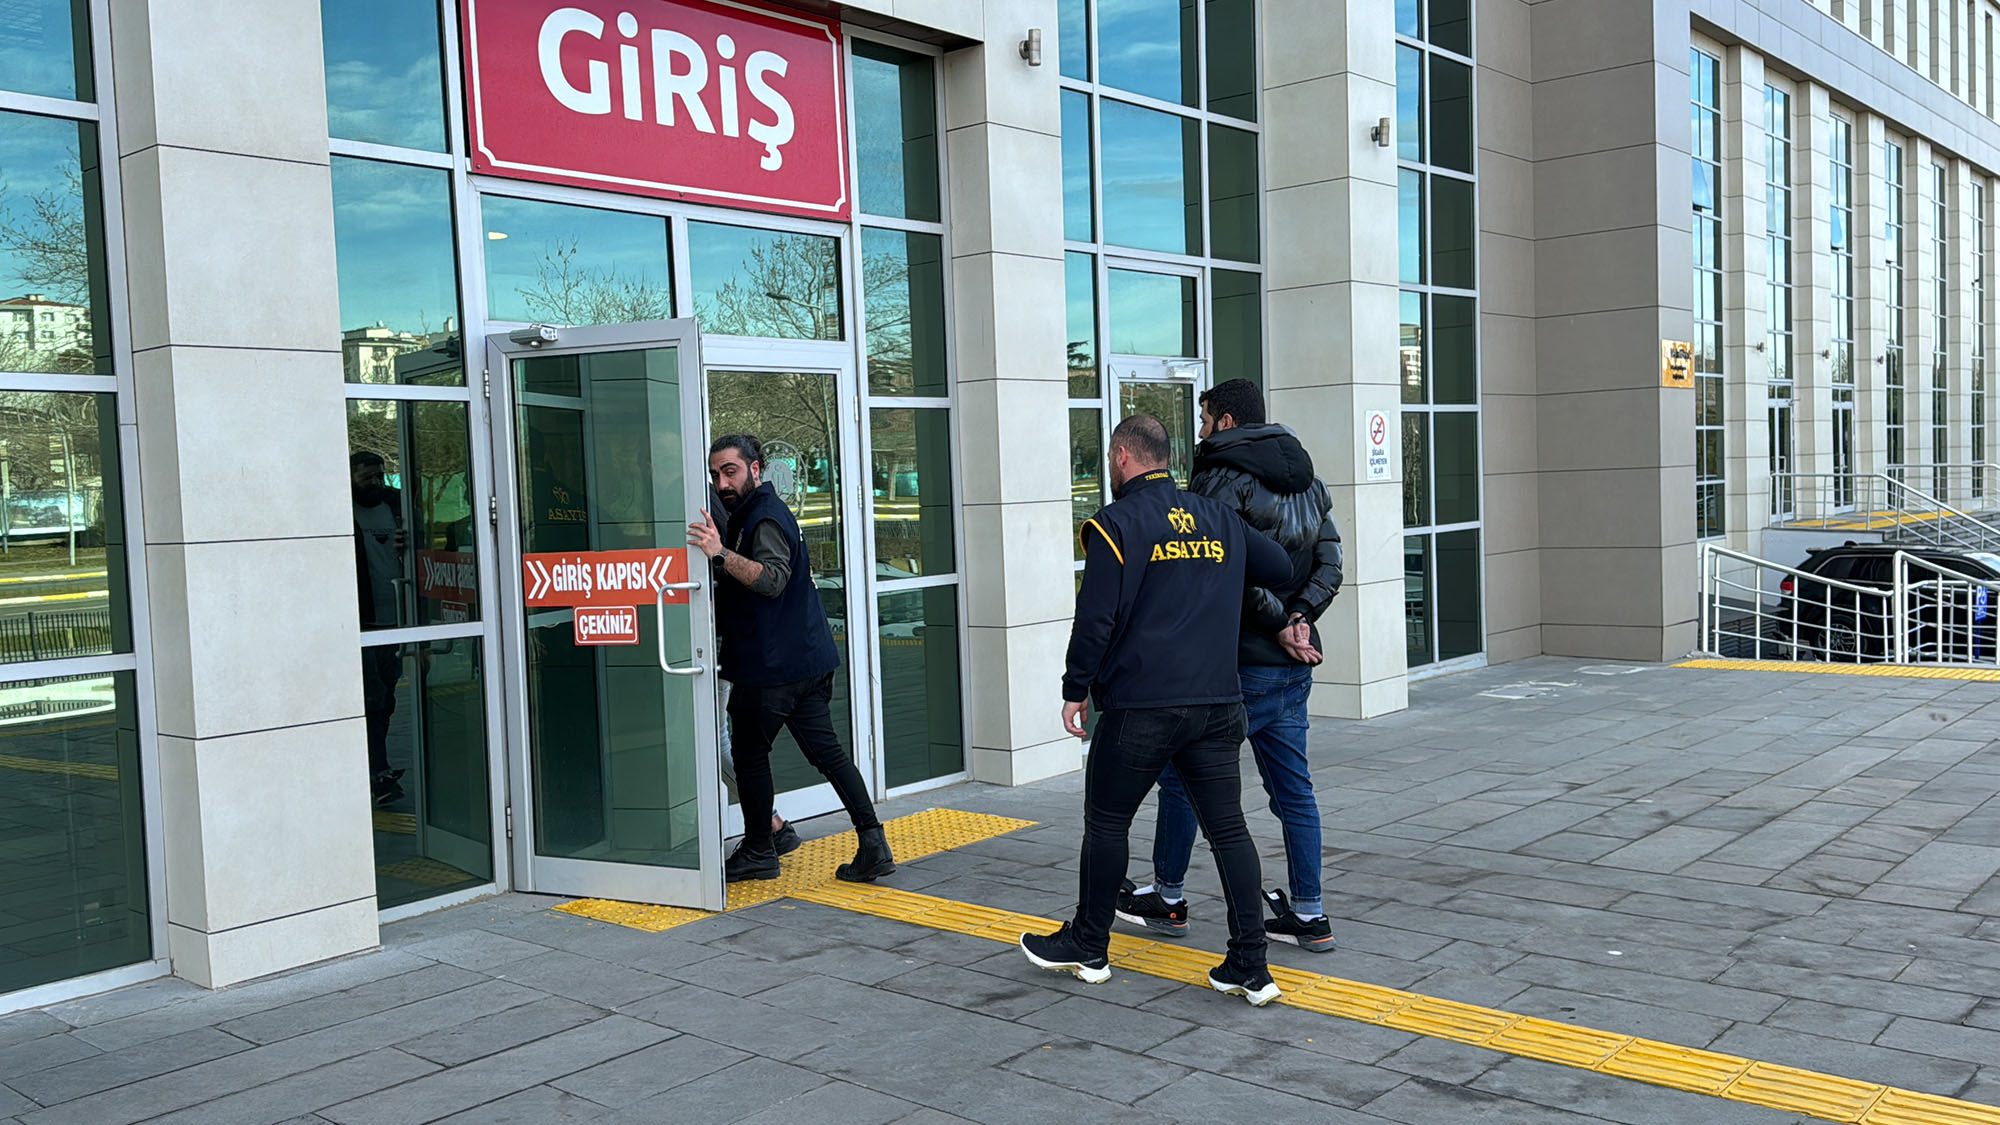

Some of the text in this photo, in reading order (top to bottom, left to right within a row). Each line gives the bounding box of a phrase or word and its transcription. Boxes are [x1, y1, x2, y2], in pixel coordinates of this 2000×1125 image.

[538, 7, 795, 172] GİRİŞ
[1150, 536, 1225, 563] ASAYİŞ
[552, 557, 648, 599] GİRİŞ KAPISI
[579, 610, 634, 640] ÇEKİNİZ
